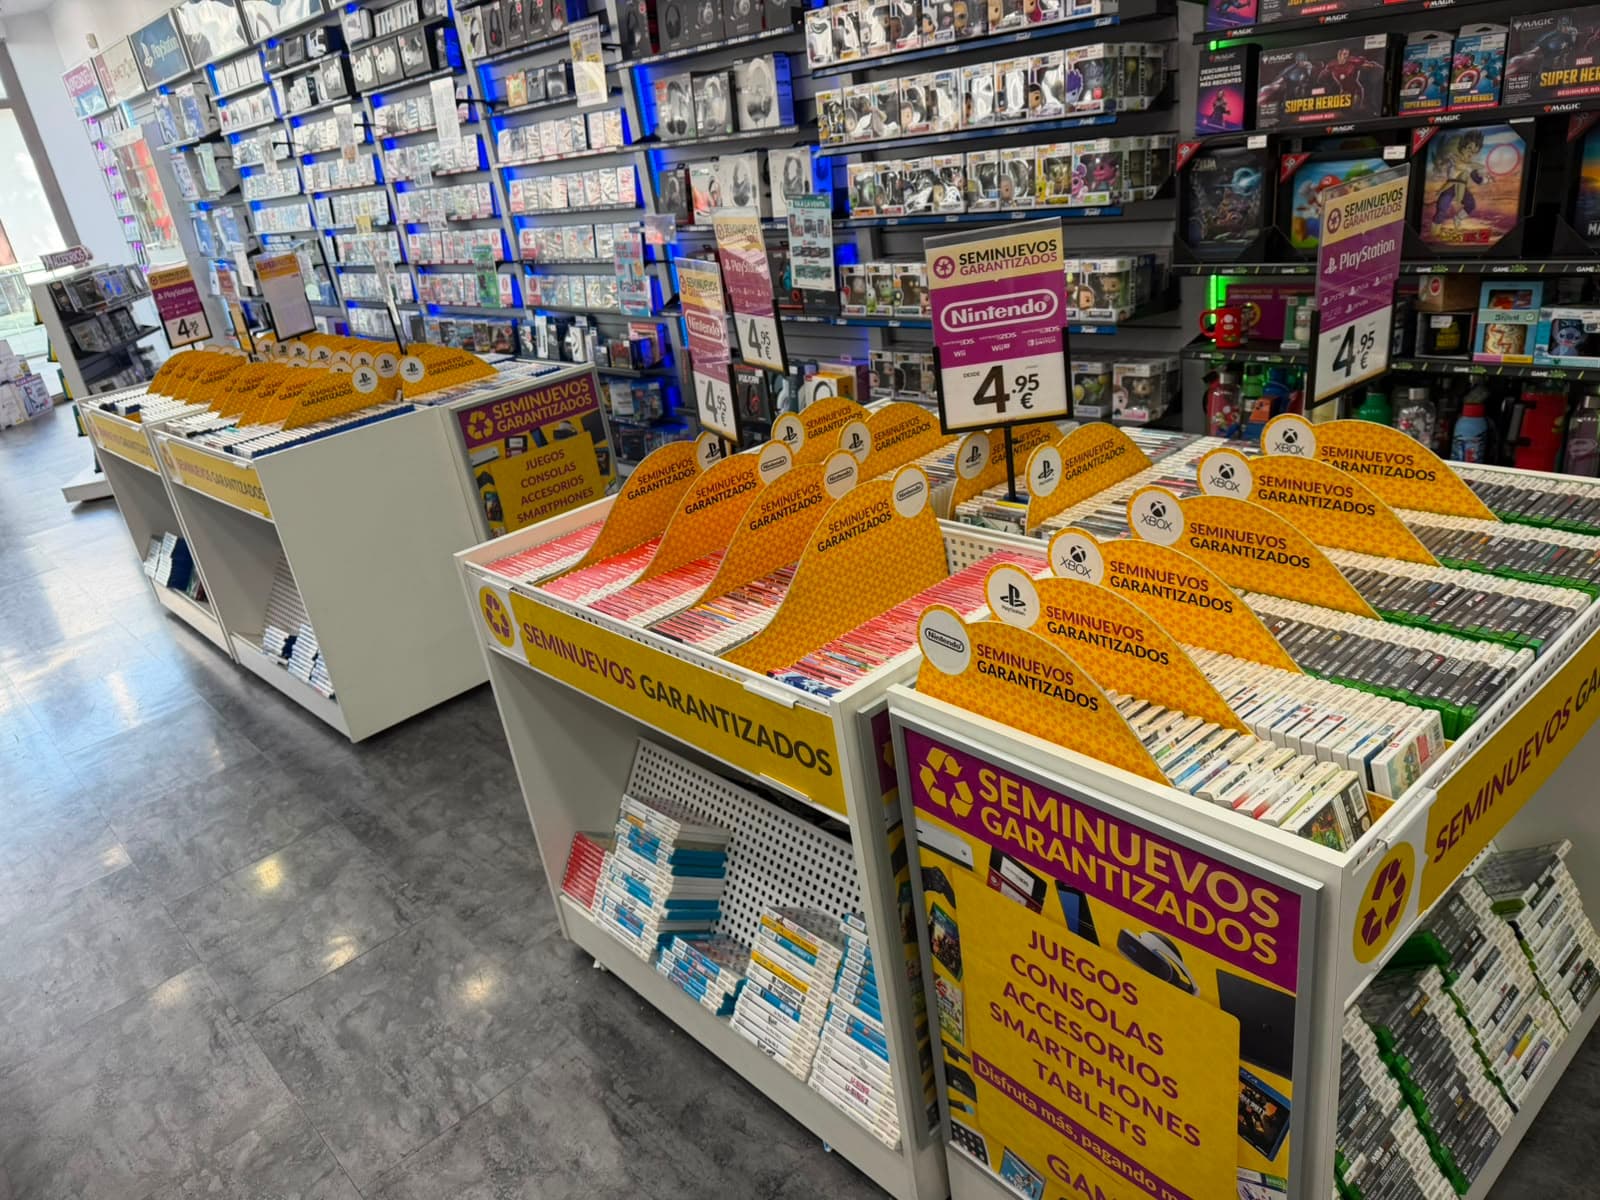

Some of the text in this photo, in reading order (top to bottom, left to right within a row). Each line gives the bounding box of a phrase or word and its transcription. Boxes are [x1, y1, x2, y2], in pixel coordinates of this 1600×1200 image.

[1326, 13, 1349, 22] MAGIC
[1523, 17, 1554, 28] MAGIC
[1540, 68, 1578, 87] SUPER
[1285, 98, 1314, 113] SUPER
[1316, 94, 1352, 110] HEROES
[1434, 114, 1461, 122] MAGIC
[1552, 103, 1581, 111] MAGIC
[1343, 201, 1403, 230] GARANTIZADOS
[1344, 186, 1404, 218] SEMINUEVOS
[958, 239, 1058, 266] SEMINUEVOS
[959, 251, 1058, 277] GARANTIZADOS
[1339, 238, 1395, 271] PlayStation
[688, 316, 721, 338] Nintendo
[950, 299, 1047, 326] Nintendo
[1360, 351, 1369, 370] €
[302, 389, 353, 407] GARANTIZADOS
[492, 378, 590, 420] SEMINUEVOS
[1020, 392, 1034, 410] €
[496, 393, 593, 433] GARANTIZADOS
[806, 405, 852, 430] SEMINUEVOS
[873, 416, 921, 443] SEMINUEVOS
[875, 422, 931, 452] GARANTIZADOS
[525, 449, 565, 471] JUEGOS
[1064, 438, 1115, 470] SEMINUEVOS
[1274, 442, 1305, 455] XBOX
[1321, 446, 1415, 466] SEMINUEVOS
[520, 462, 577, 489] CONSOLAS
[637, 457, 694, 486] SEMINUEVOS
[763, 457, 786, 470] Nintendo
[829, 468, 852, 483] Nintendo
[1065, 446, 1126, 481] GARANTIZADOS
[520, 475, 584, 507] ACCESORIOS
[627, 467, 696, 500] GARANTIZADOS
[685, 479, 757, 515] GARANTIZADOS
[696, 469, 754, 498] SEMINUEVOS
[760, 481, 821, 514] SEMINUEVOS
[899, 484, 923, 499] Nintendo
[1208, 475, 1240, 493] XBOX
[1258, 475, 1353, 499] SEMINUEVOS
[517, 487, 594, 523] SMARTPHONES
[749, 492, 823, 531] GARANTIZADOS
[1257, 488, 1376, 516] GARANTIZADOS
[817, 510, 892, 552] GARANTIZADOS
[828, 499, 889, 535] SEMINUEVOS
[1140, 513, 1173, 532] XBOX
[1190, 522, 1287, 550] SEMINUEVOS
[1060, 556, 1092, 579] XBOX
[1190, 537, 1311, 569] GARANTIZADOS
[1110, 561, 1209, 592] SEMINUEVOS
[1110, 576, 1233, 613] GARANTIZADOS
[1046, 606, 1145, 642] SEMINUEVOS
[927, 631, 963, 650] Nintendo
[1047, 621, 1169, 665] GARANTIZADOS
[976, 644, 1074, 686] SEMINUEVOS
[523, 622, 833, 777] SEMINUEVOS GARANTIZADOS
[977, 660, 1099, 711] GARANTIZADOS
[1433, 696, 1572, 864] SEMINUEVOS
[978, 769, 1280, 928] SEMINUEVOS
[980, 806, 1278, 966] GARANTIZADOS
[1027, 930, 1139, 1006] JUEGOS
[1010, 954, 1164, 1056] CONSOLAS
[1003, 982, 1179, 1100] ACCESORIOS
[989, 1002, 1201, 1148] SMARTPHONES
[1033, 1059, 1147, 1147] TABLETS
[978, 1059, 1039, 1113] Disfruta
[1040, 1105, 1079, 1142] más,
[1081, 1135, 1157, 1193] pagando
